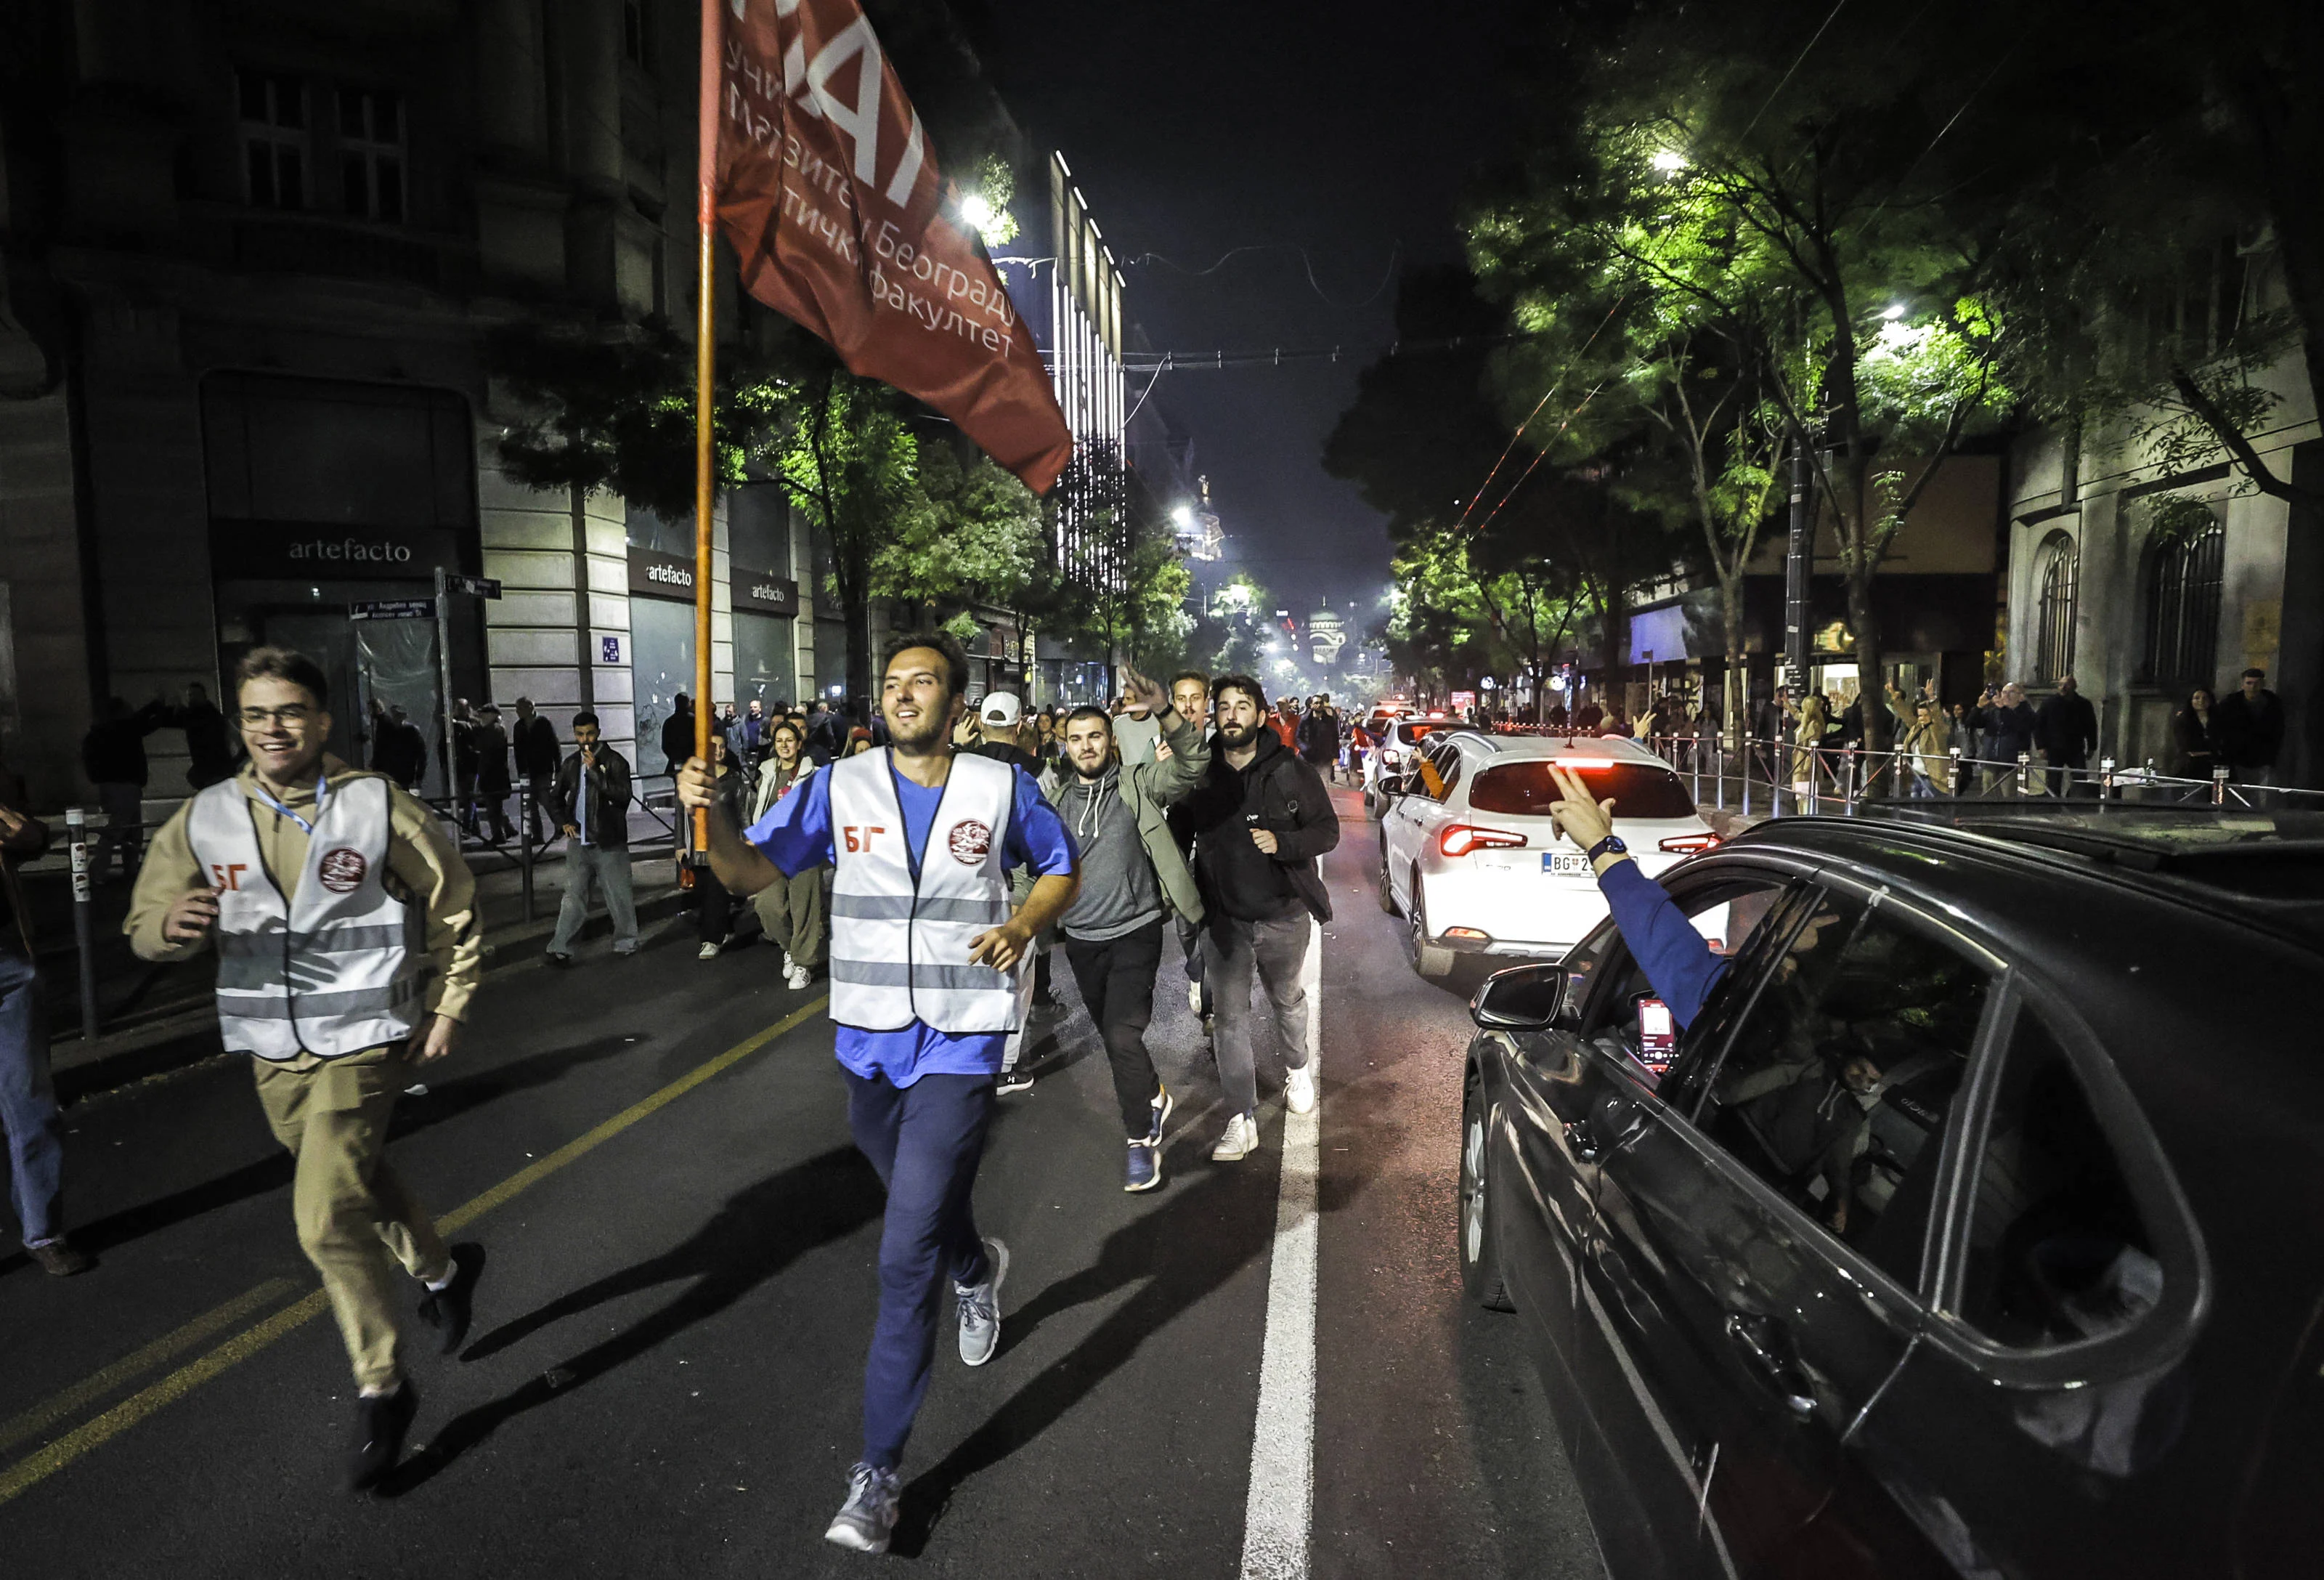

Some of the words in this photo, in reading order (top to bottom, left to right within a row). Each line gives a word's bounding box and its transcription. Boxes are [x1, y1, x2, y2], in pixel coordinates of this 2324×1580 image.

[875, 219, 1015, 327] Београду
[869, 262, 1014, 357] факултет
[289, 538, 411, 562] artefacto
[648, 564, 692, 587] artefacto
[752, 584, 784, 602] artefacto
[842, 826, 885, 853] БГ
[1554, 856, 1570, 870] BG
